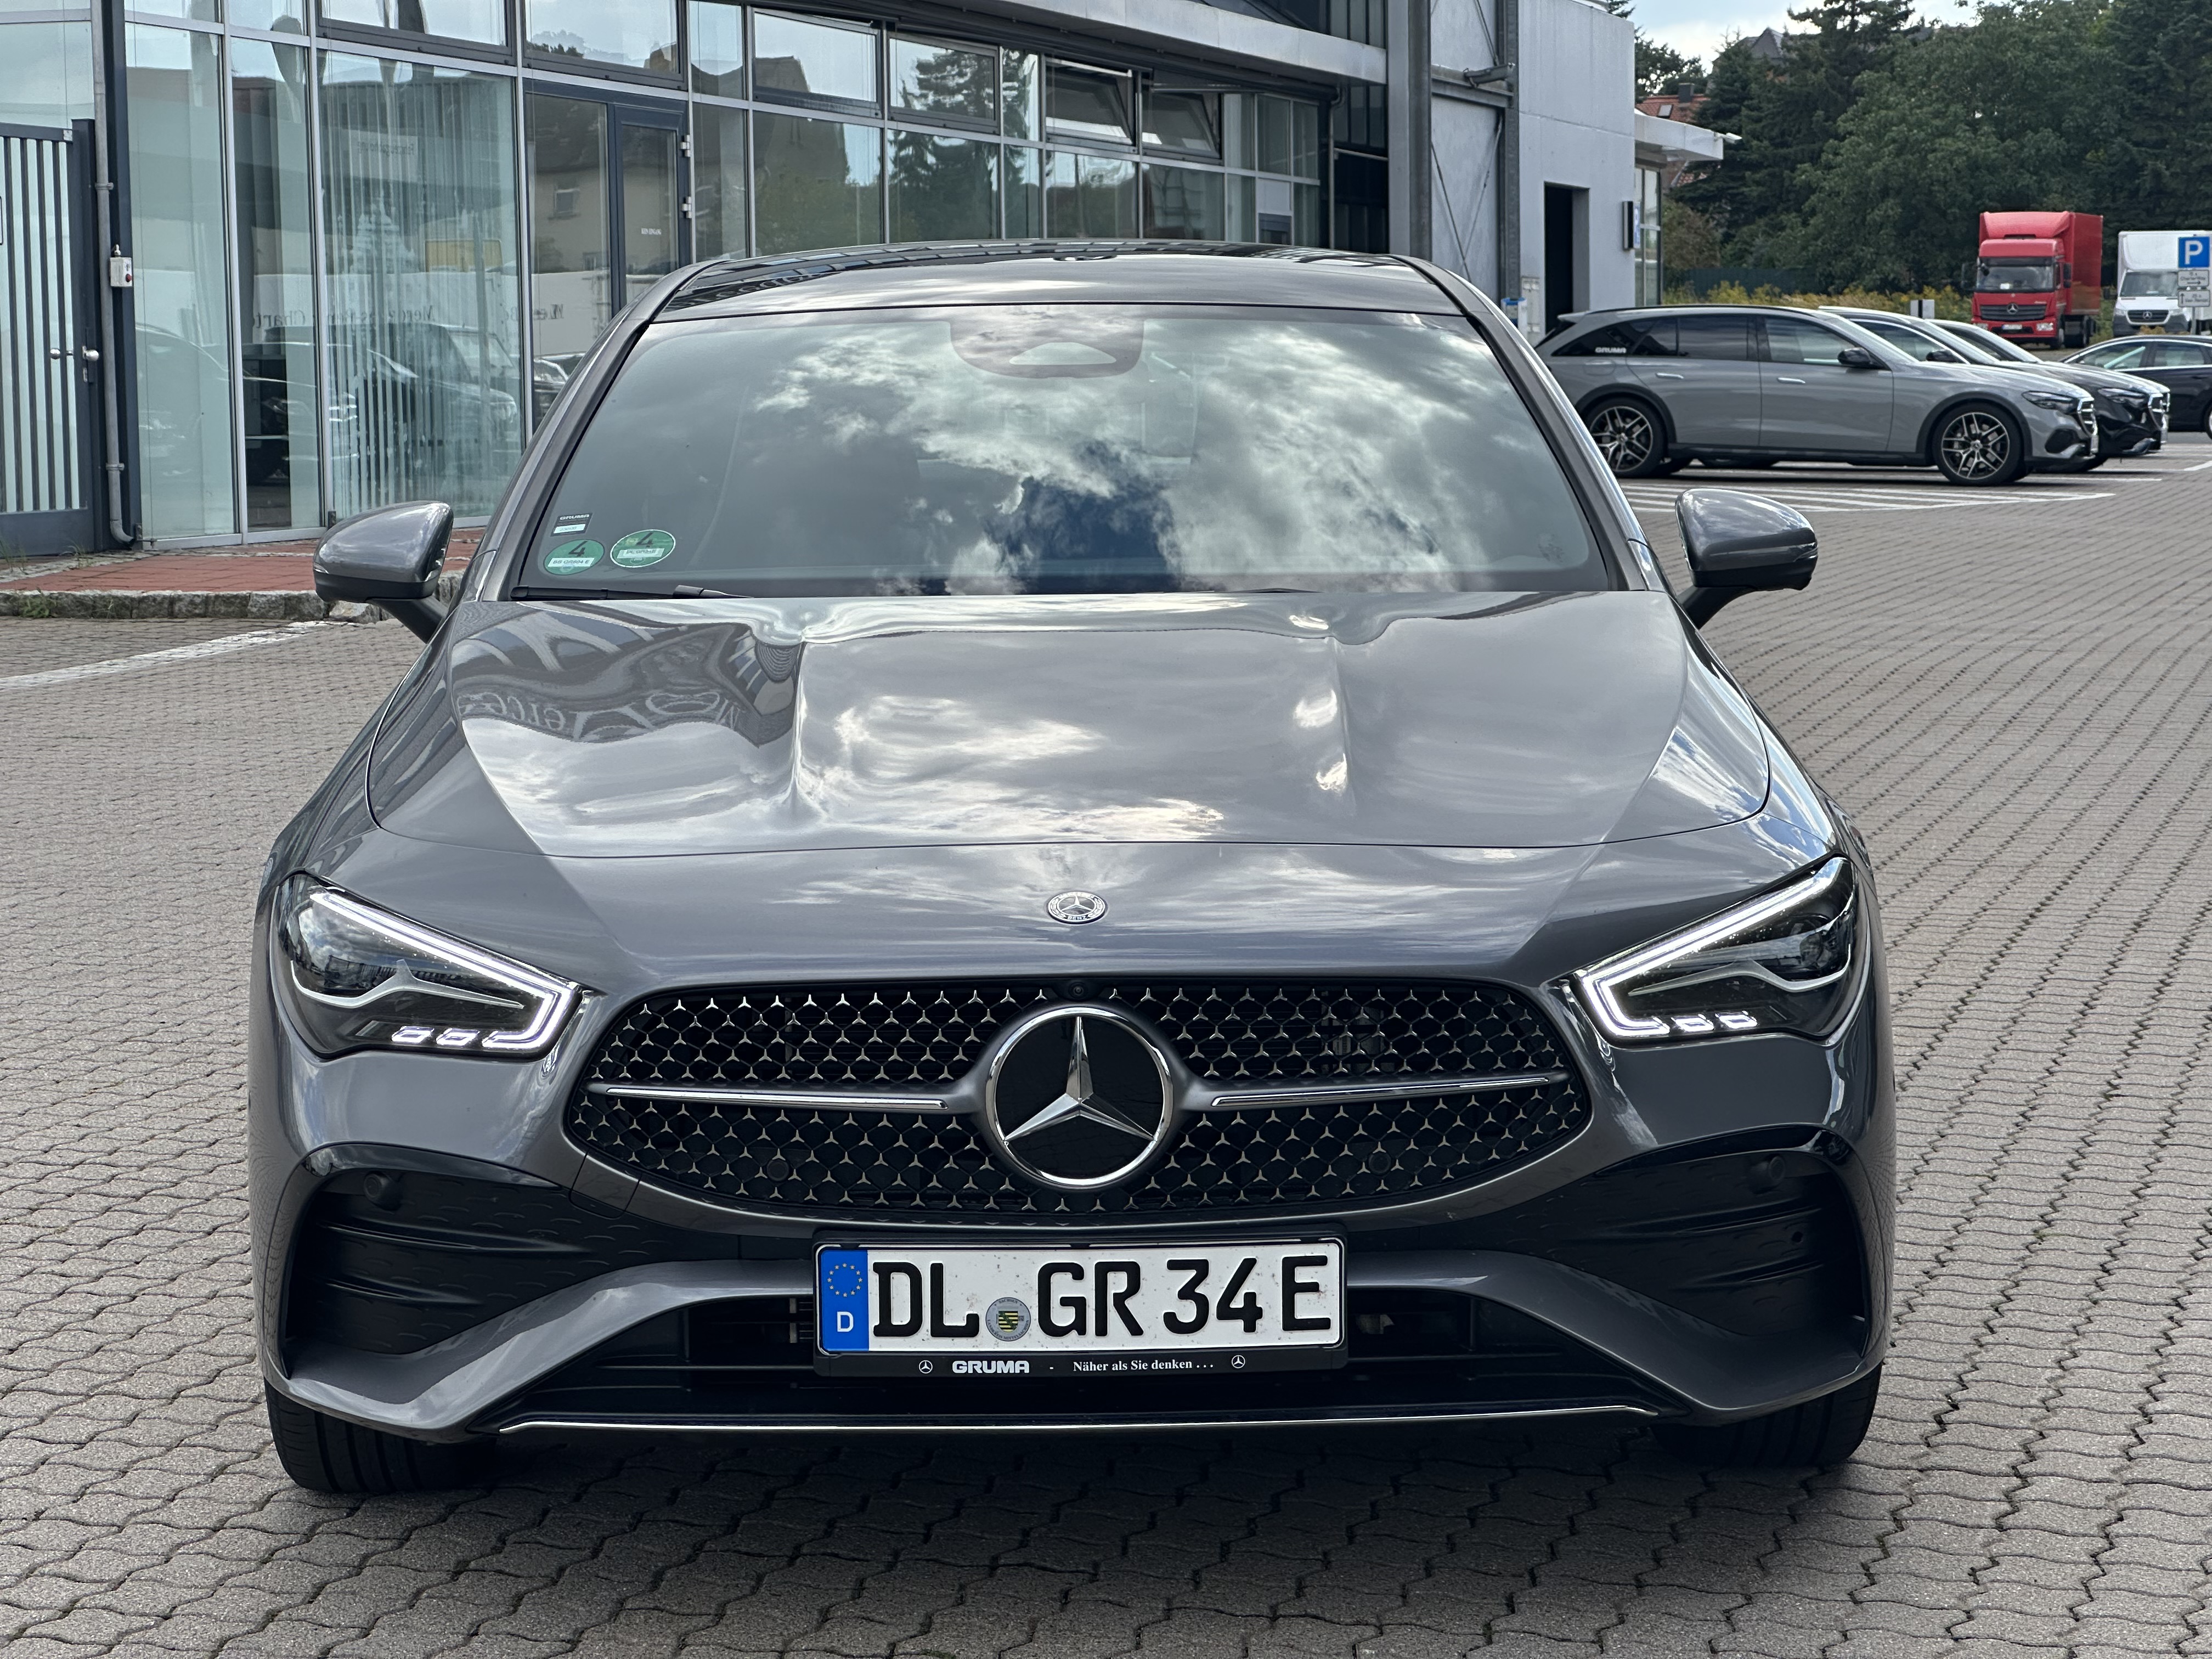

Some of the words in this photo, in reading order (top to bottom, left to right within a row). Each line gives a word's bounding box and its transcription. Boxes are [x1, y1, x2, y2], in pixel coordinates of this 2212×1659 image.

[2185, 241, 2203, 265] P
[568, 540, 589, 557] 4
[636, 532, 653, 548] 4
[872, 1261, 980, 1339] DL
[1037, 1260, 1144, 1338] GR
[836, 1311, 854, 1333] D
[952, 1360, 1030, 1374] GRUMA
[1073, 1359, 1109, 1372] Näher
[1112, 1359, 1128, 1372] als
[1131, 1359, 1148, 1371] Sie
[1151, 1359, 1193, 1371] denken
